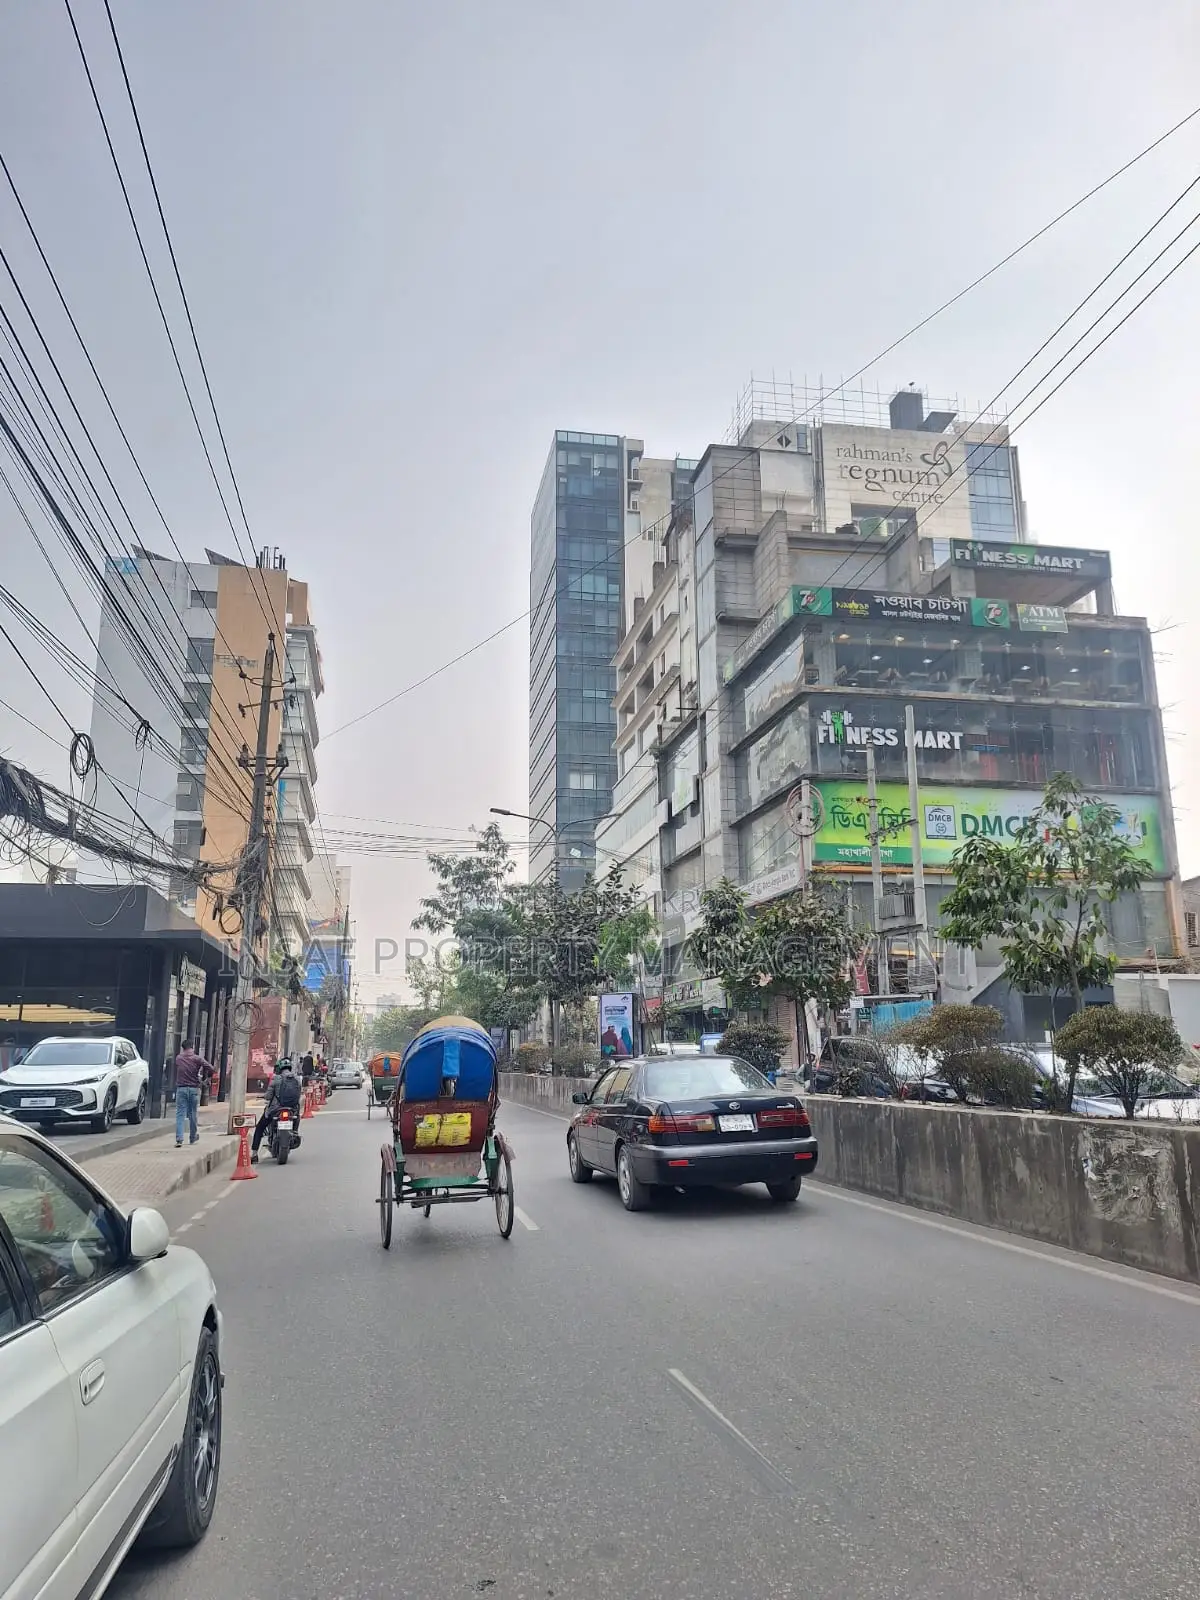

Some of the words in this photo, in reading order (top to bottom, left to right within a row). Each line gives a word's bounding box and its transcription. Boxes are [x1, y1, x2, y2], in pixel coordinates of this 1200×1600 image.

[836, 443, 913, 463] rahman's
[837, 464, 941, 493] regnum
[892, 490, 945, 505] centre
[1034, 554, 1085, 569] MART
[873, 595, 923, 610] নওয়াব
[1028, 606, 1060, 618] ATM
[928, 813, 952, 823] DMCB
[960, 813, 1034, 838] DMC
[873, 849, 893, 858] াখা
